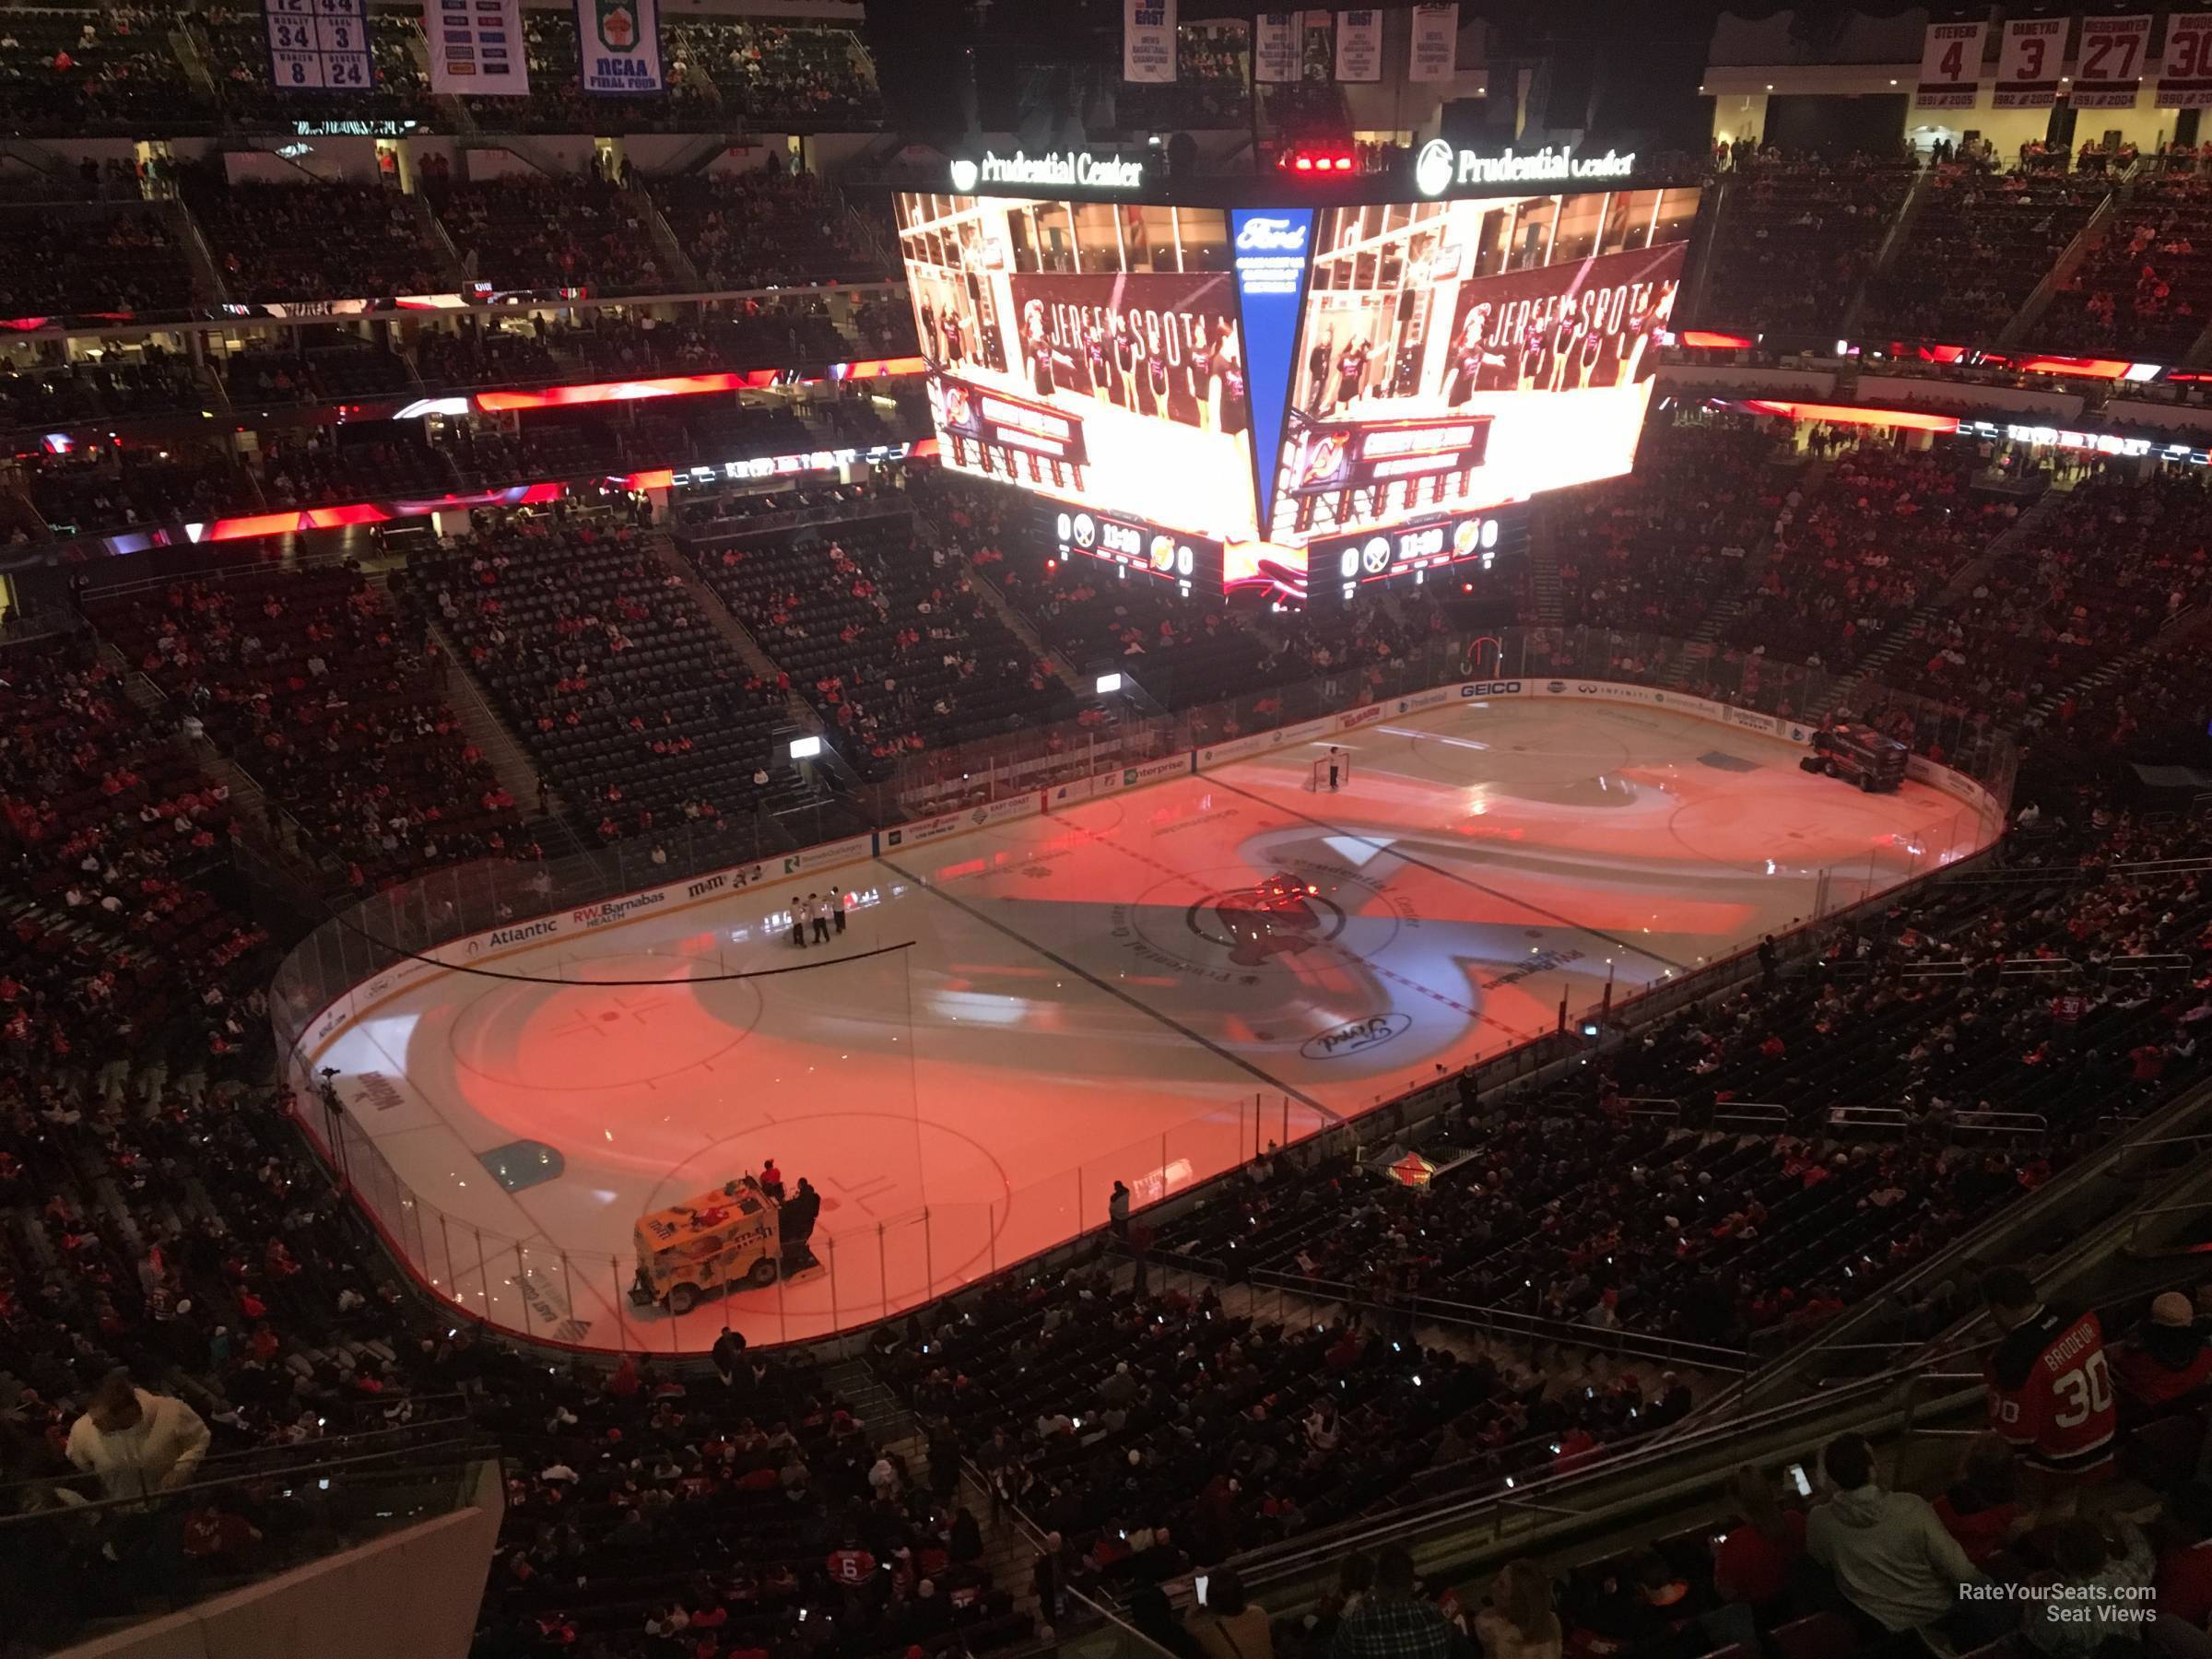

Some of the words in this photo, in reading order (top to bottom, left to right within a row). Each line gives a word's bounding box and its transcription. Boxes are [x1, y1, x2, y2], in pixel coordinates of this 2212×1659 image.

[278, 26, 308, 47] 34
[335, 28, 349, 48] 3
[1935, 26, 1978, 40] STEVENS
[2012, 21, 2060, 36] DANEYKO
[1940, 41, 1963, 81] 4
[2017, 39, 2045, 79] 3
[2082, 34, 2140, 79] 27
[292, 63, 306, 84] 8
[332, 64, 362, 84] 24
[590, 76, 625, 88] FINAL
[1949, 95, 1973, 105] 2005
[2030, 94, 2054, 104] 2003
[2107, 95, 2135, 105] 2004
[982, 150, 1077, 184] Prudential
[1077, 152, 1143, 186] Center
[1457, 146, 1571, 182] Prudential
[1237, 218, 1307, 250] Ford
[1057, 513, 1071, 541] 0
[1481, 519, 1499, 548] 0
[1177, 546, 1194, 575] 0
[1342, 547, 1359, 577] 0
[1461, 681, 1522, 698] GEICO
[1601, 688, 1649, 699] INFINITI
[990, 803, 1007, 812] EAST
[1008, 796, 1030, 807] COAST
[586, 912, 625, 928] HEALTH
[489, 920, 558, 947] Atlantic
[1123, 941, 1231, 982] Prudential
[2063, 1001, 2079, 1014] 30
[1318, 1018, 1393, 1053] Ford
[2052, 1349, 2112, 1429] 30
[842, 1559, 858, 1579] 6
